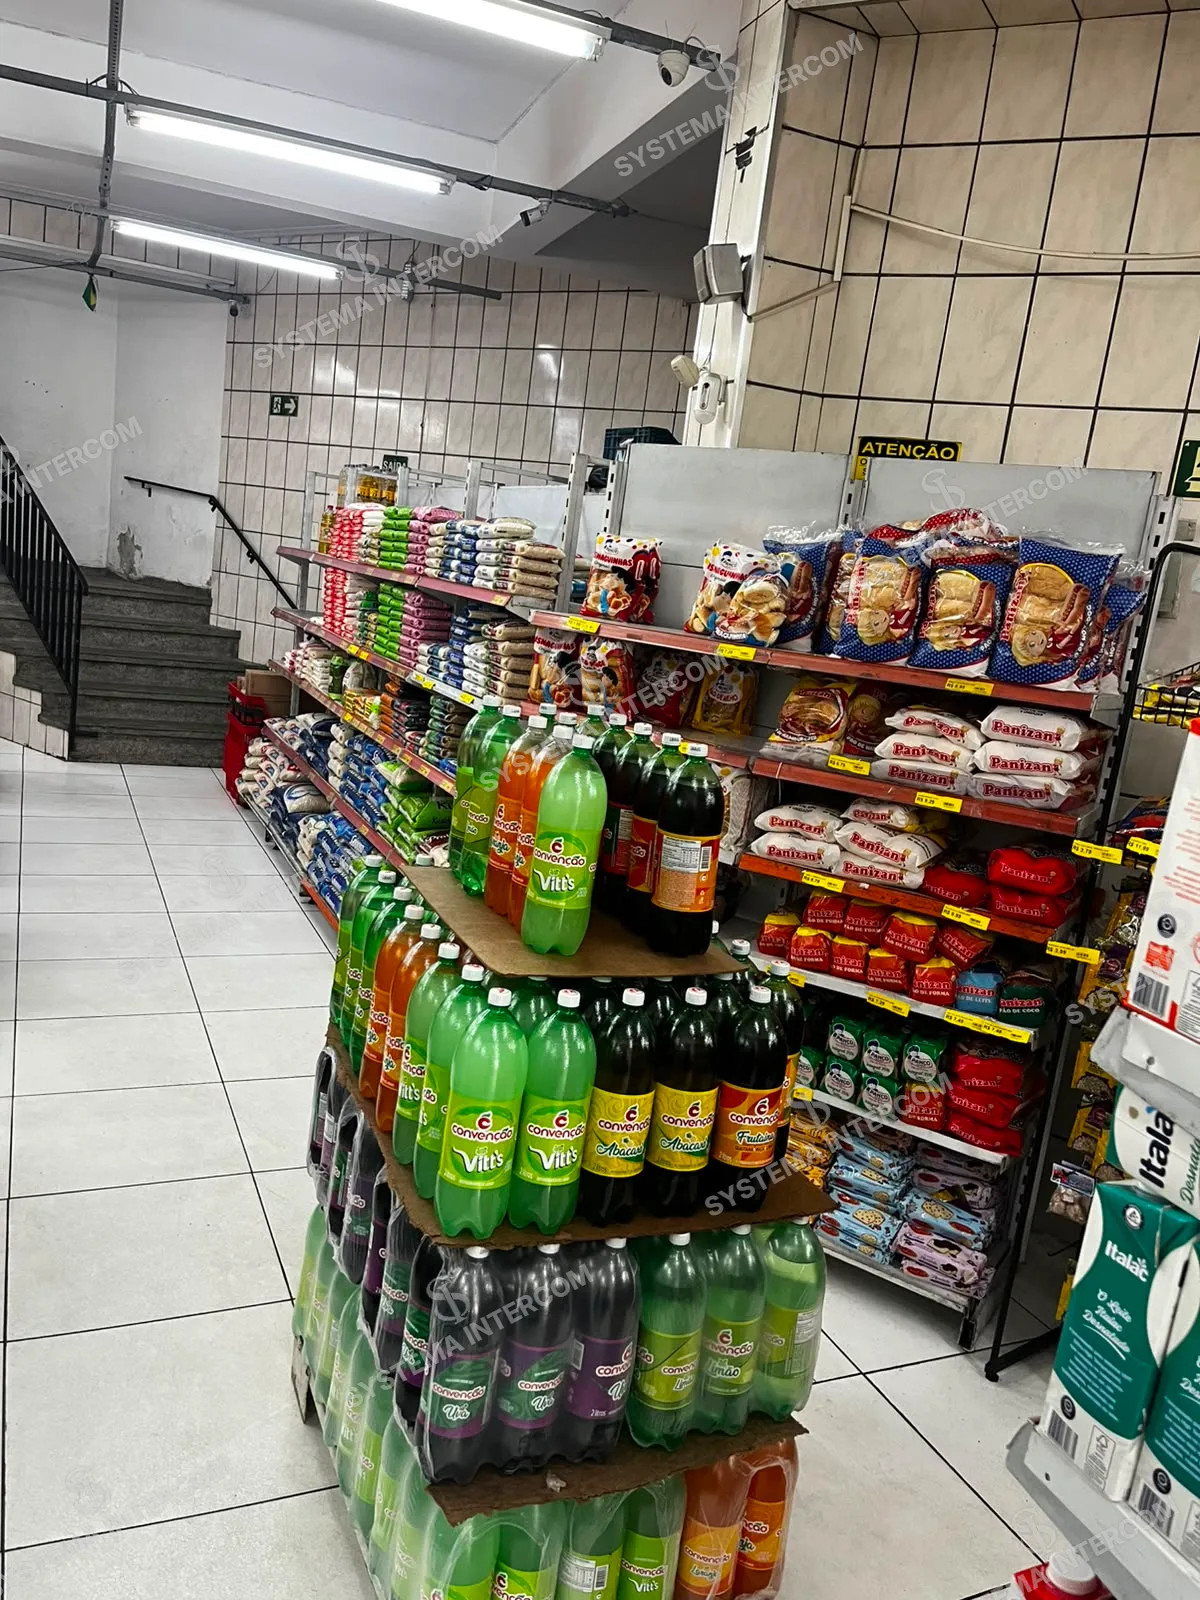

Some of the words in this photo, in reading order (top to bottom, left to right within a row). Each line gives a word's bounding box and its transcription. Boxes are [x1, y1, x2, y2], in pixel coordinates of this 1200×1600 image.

[862, 442, 955, 460] ATENÇÃO
[992, 720, 1056, 742] Panizan
[893, 743, 955, 763] Panizan
[990, 755, 1053, 773] Panizan
[888, 764, 951, 785] Panizan
[983, 783, 1046, 800] Panizan
[534, 848, 586, 867] convenção
[767, 846, 819, 862] Panizan
[533, 868, 575, 892] Vitt's
[843, 862, 901, 882] Panizan
[1000, 862, 1048, 884] Panizan
[400, 1083, 420, 1101] itt's
[451, 1122, 513, 1144] convenção
[452, 1146, 504, 1173] Vitt's
[528, 1145, 577, 1171] Vitt's
[1138, 1110, 1175, 1189] Itala
[1105, 1240, 1149, 1282] Italac
[432, 1382, 487, 1400] convenção
[443, 1402, 470, 1419] Uva
[628, 1578, 659, 1593] Vitt's
